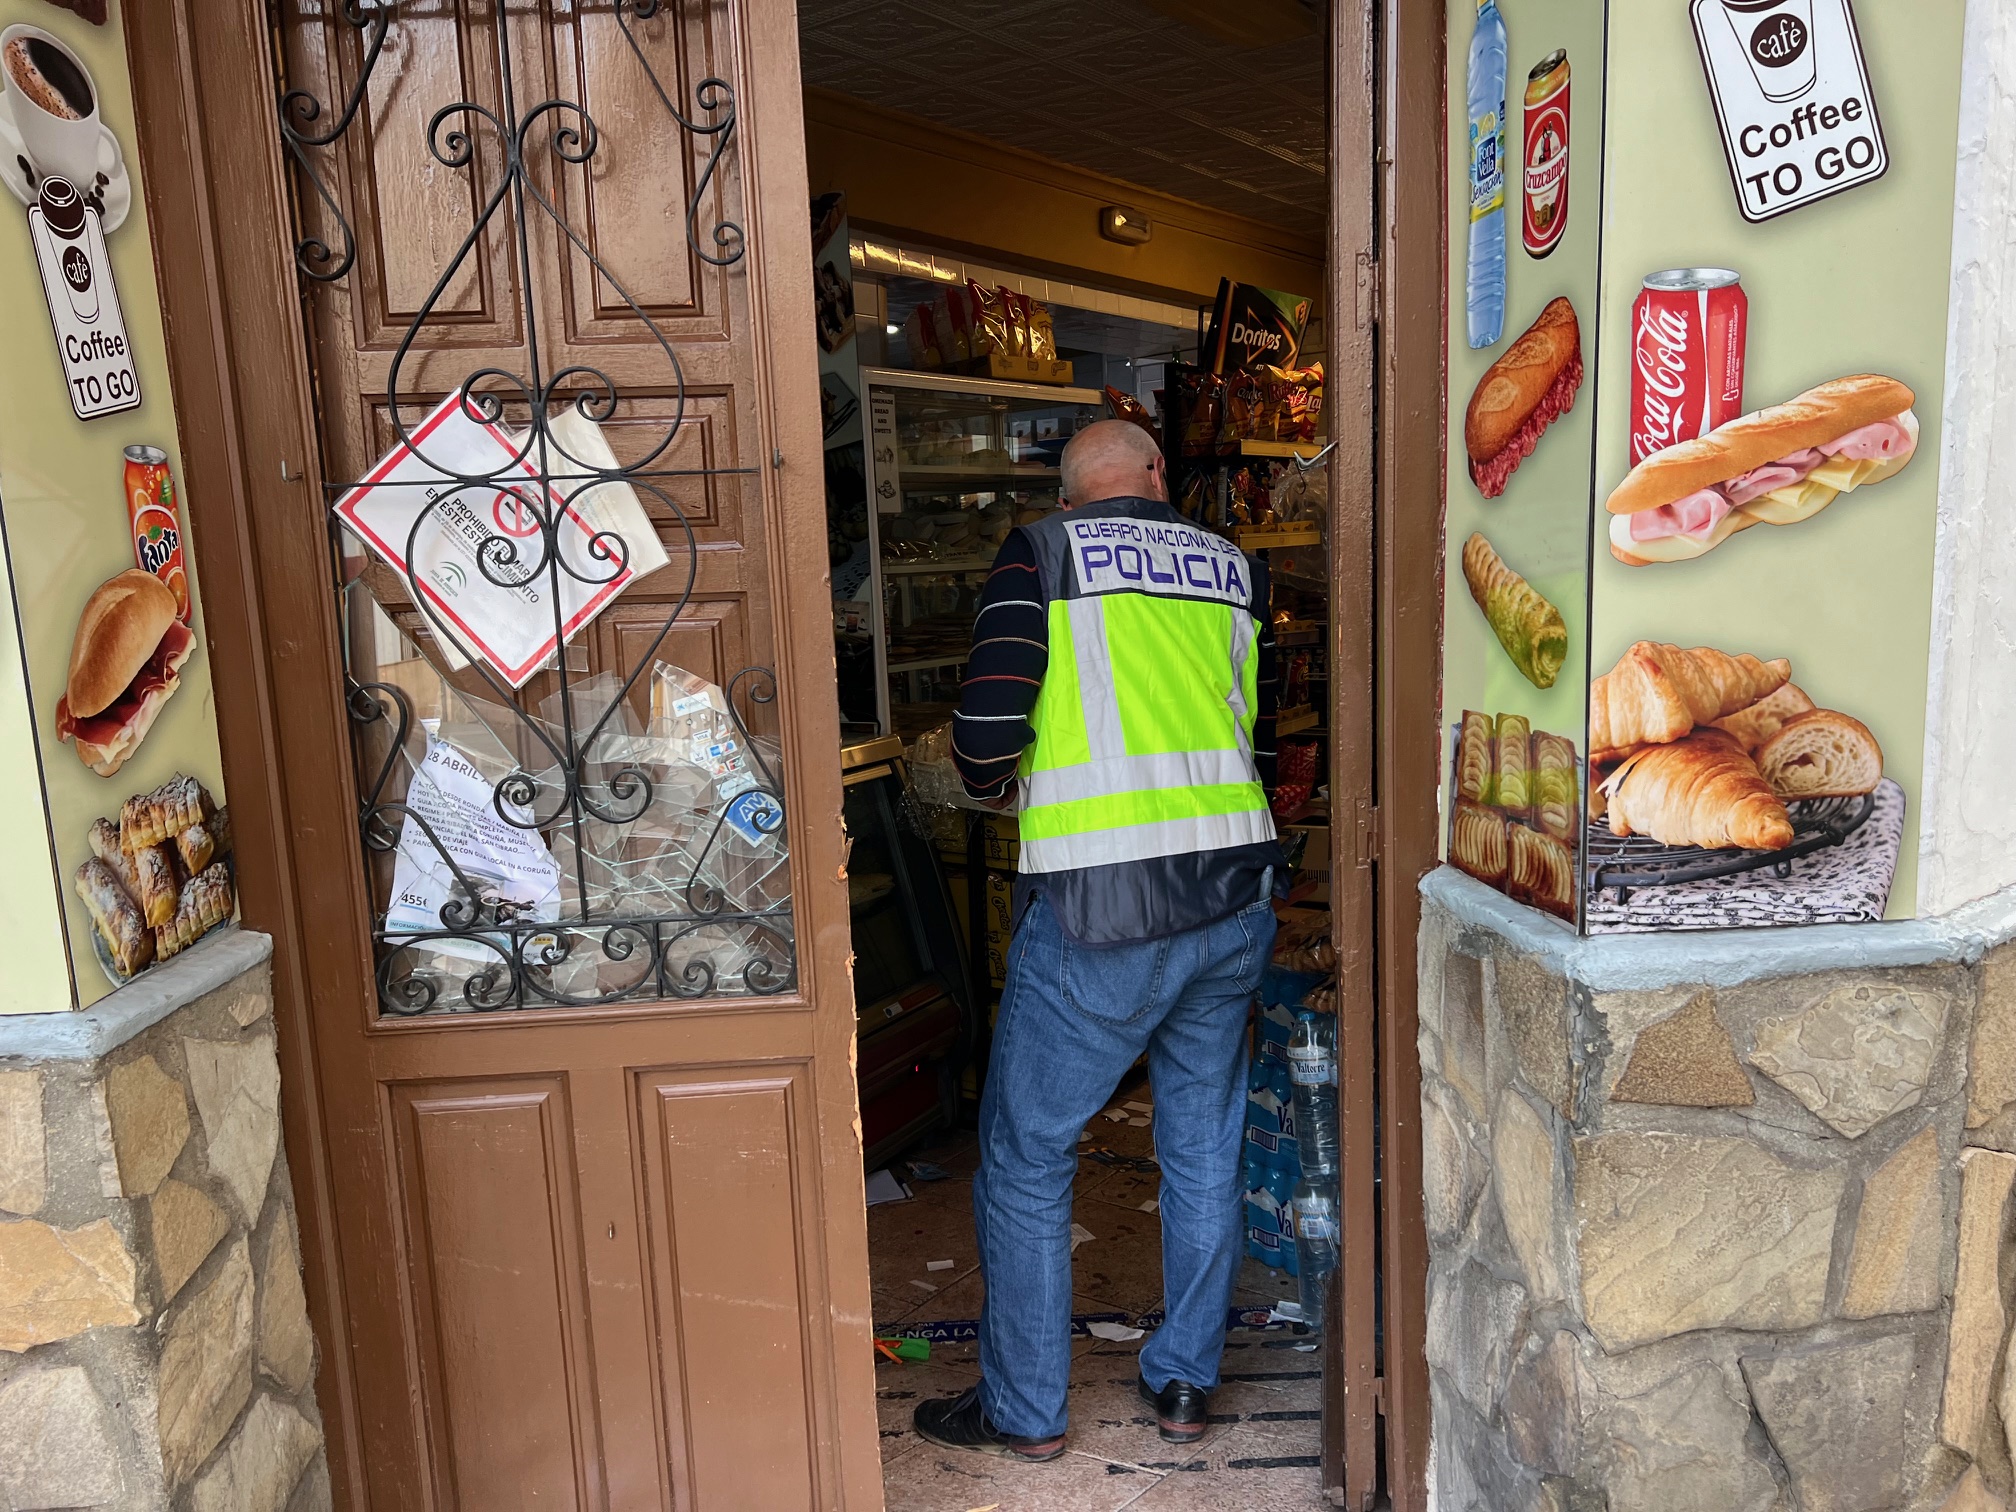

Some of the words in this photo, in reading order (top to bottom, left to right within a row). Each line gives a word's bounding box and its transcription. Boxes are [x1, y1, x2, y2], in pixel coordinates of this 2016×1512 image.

[1756, 22, 1803, 61] café
[1739, 96, 1864, 159] Coffee
[1478, 158, 1495, 177] Vella
[1479, 143, 1495, 161] Font
[1525, 150, 1568, 190] Cruzcampo
[1745, 167, 1803, 206] TO
[1814, 135, 1876, 181] GO
[65, 251, 89, 285] café
[65, 330, 126, 365] Coffee
[1231, 322, 1282, 351] Doritos
[73, 375, 102, 407] TO
[106, 368, 135, 399] GO
[439, 501, 465, 527] ESTE
[451, 497, 500, 547] PROHIBIDO
[137, 527, 179, 576] Fanta
[1075, 523, 1142, 542] CUERPO
[1145, 527, 1218, 551] NACIONAL
[1218, 540, 1239, 557] DE
[1081, 545, 1247, 597] POLICIA
[441, 756, 478, 780] ABRIL
[442, 791, 462, 804] DESDE
[462, 800, 486, 814] RONDA
[739, 792, 767, 823] AM
[442, 836, 452, 844] DE
[452, 837, 468, 847] VIAJE
[459, 847, 474, 857] CON
[487, 857, 508, 867] LOCAL
[522, 866, 552, 876] CORUÑA
[954, 1327, 976, 1337] LA
